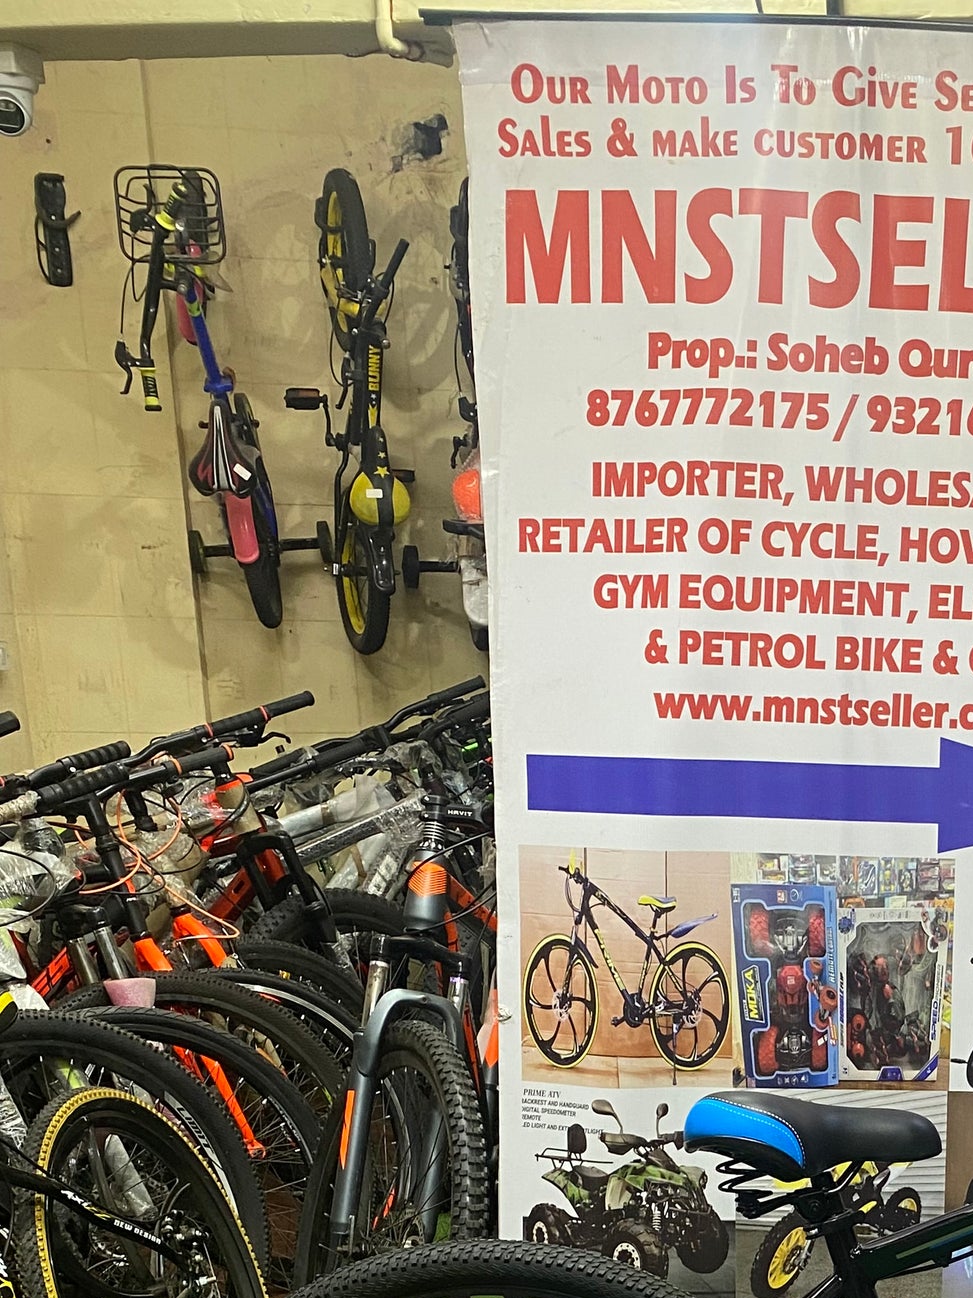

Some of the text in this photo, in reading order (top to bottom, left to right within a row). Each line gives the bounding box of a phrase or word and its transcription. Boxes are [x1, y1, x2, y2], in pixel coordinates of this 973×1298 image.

[607, 118, 637, 158] &
[368, 345, 380, 390] BUNNY
[648, 332, 757, 379] Prop.:
[767, 333, 889, 375] Soheb
[586, 388, 829, 430] 8767772175
[833, 395, 858, 442] /
[592, 460, 793, 506] IMPORTER,
[518, 517, 688, 553] RETAILER
[698, 518, 752, 555] OF
[761, 521, 888, 567] CYCLE,
[594, 574, 669, 609] GYM
[679, 574, 917, 624] EQUIPMENT,
[644, 629, 668, 664] &
[679, 630, 826, 670] PETROL
[836, 636, 923, 673] BIKE
[933, 640, 958, 675] &
[748, 968, 758, 1018] MOKA
[523, 1088, 546, 1097] PRIME
